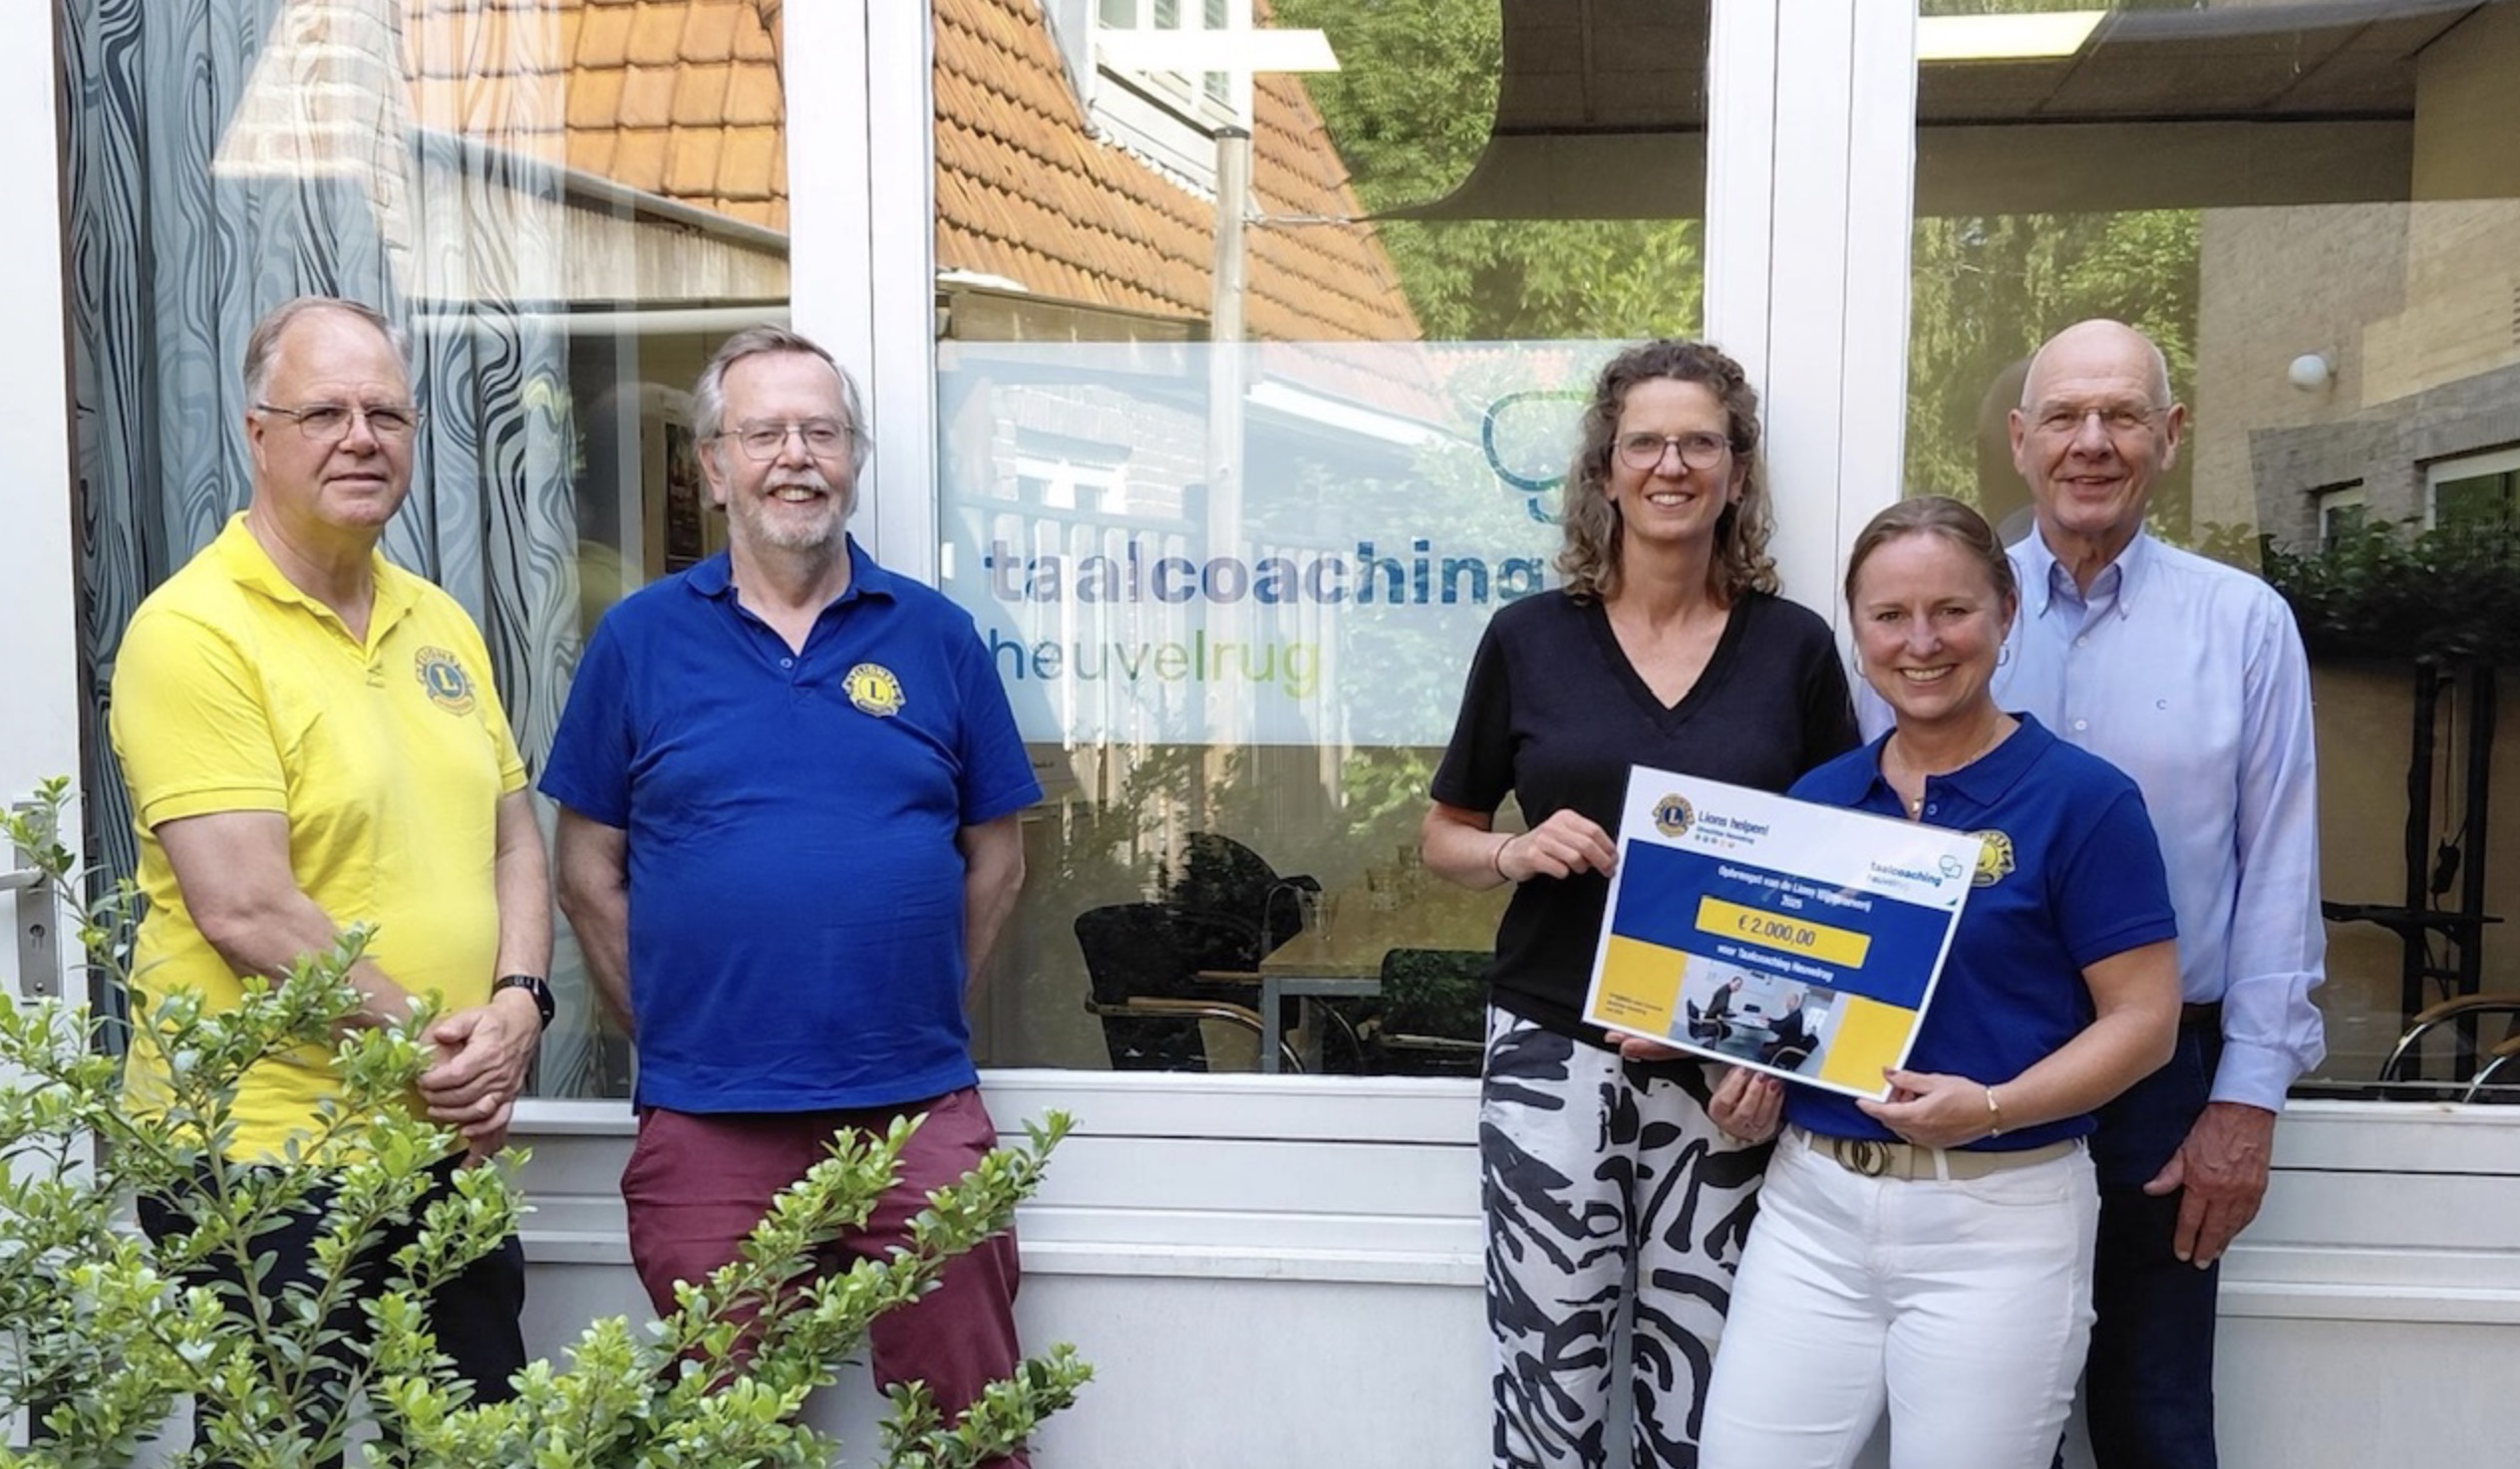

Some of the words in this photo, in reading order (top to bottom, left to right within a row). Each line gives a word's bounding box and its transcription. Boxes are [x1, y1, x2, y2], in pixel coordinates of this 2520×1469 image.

[984, 539, 1543, 605] taalcoaching
[990, 630, 1320, 698] heuvelrug
[435, 667, 460, 691] L
[1698, 810, 1728, 827] Lions
[1730, 817, 1769, 836] helpen!
[1871, 861, 1943, 887] taalcoaching
[1737, 914, 1748, 931] €
[1750, 917, 1816, 947] 2.000,00
